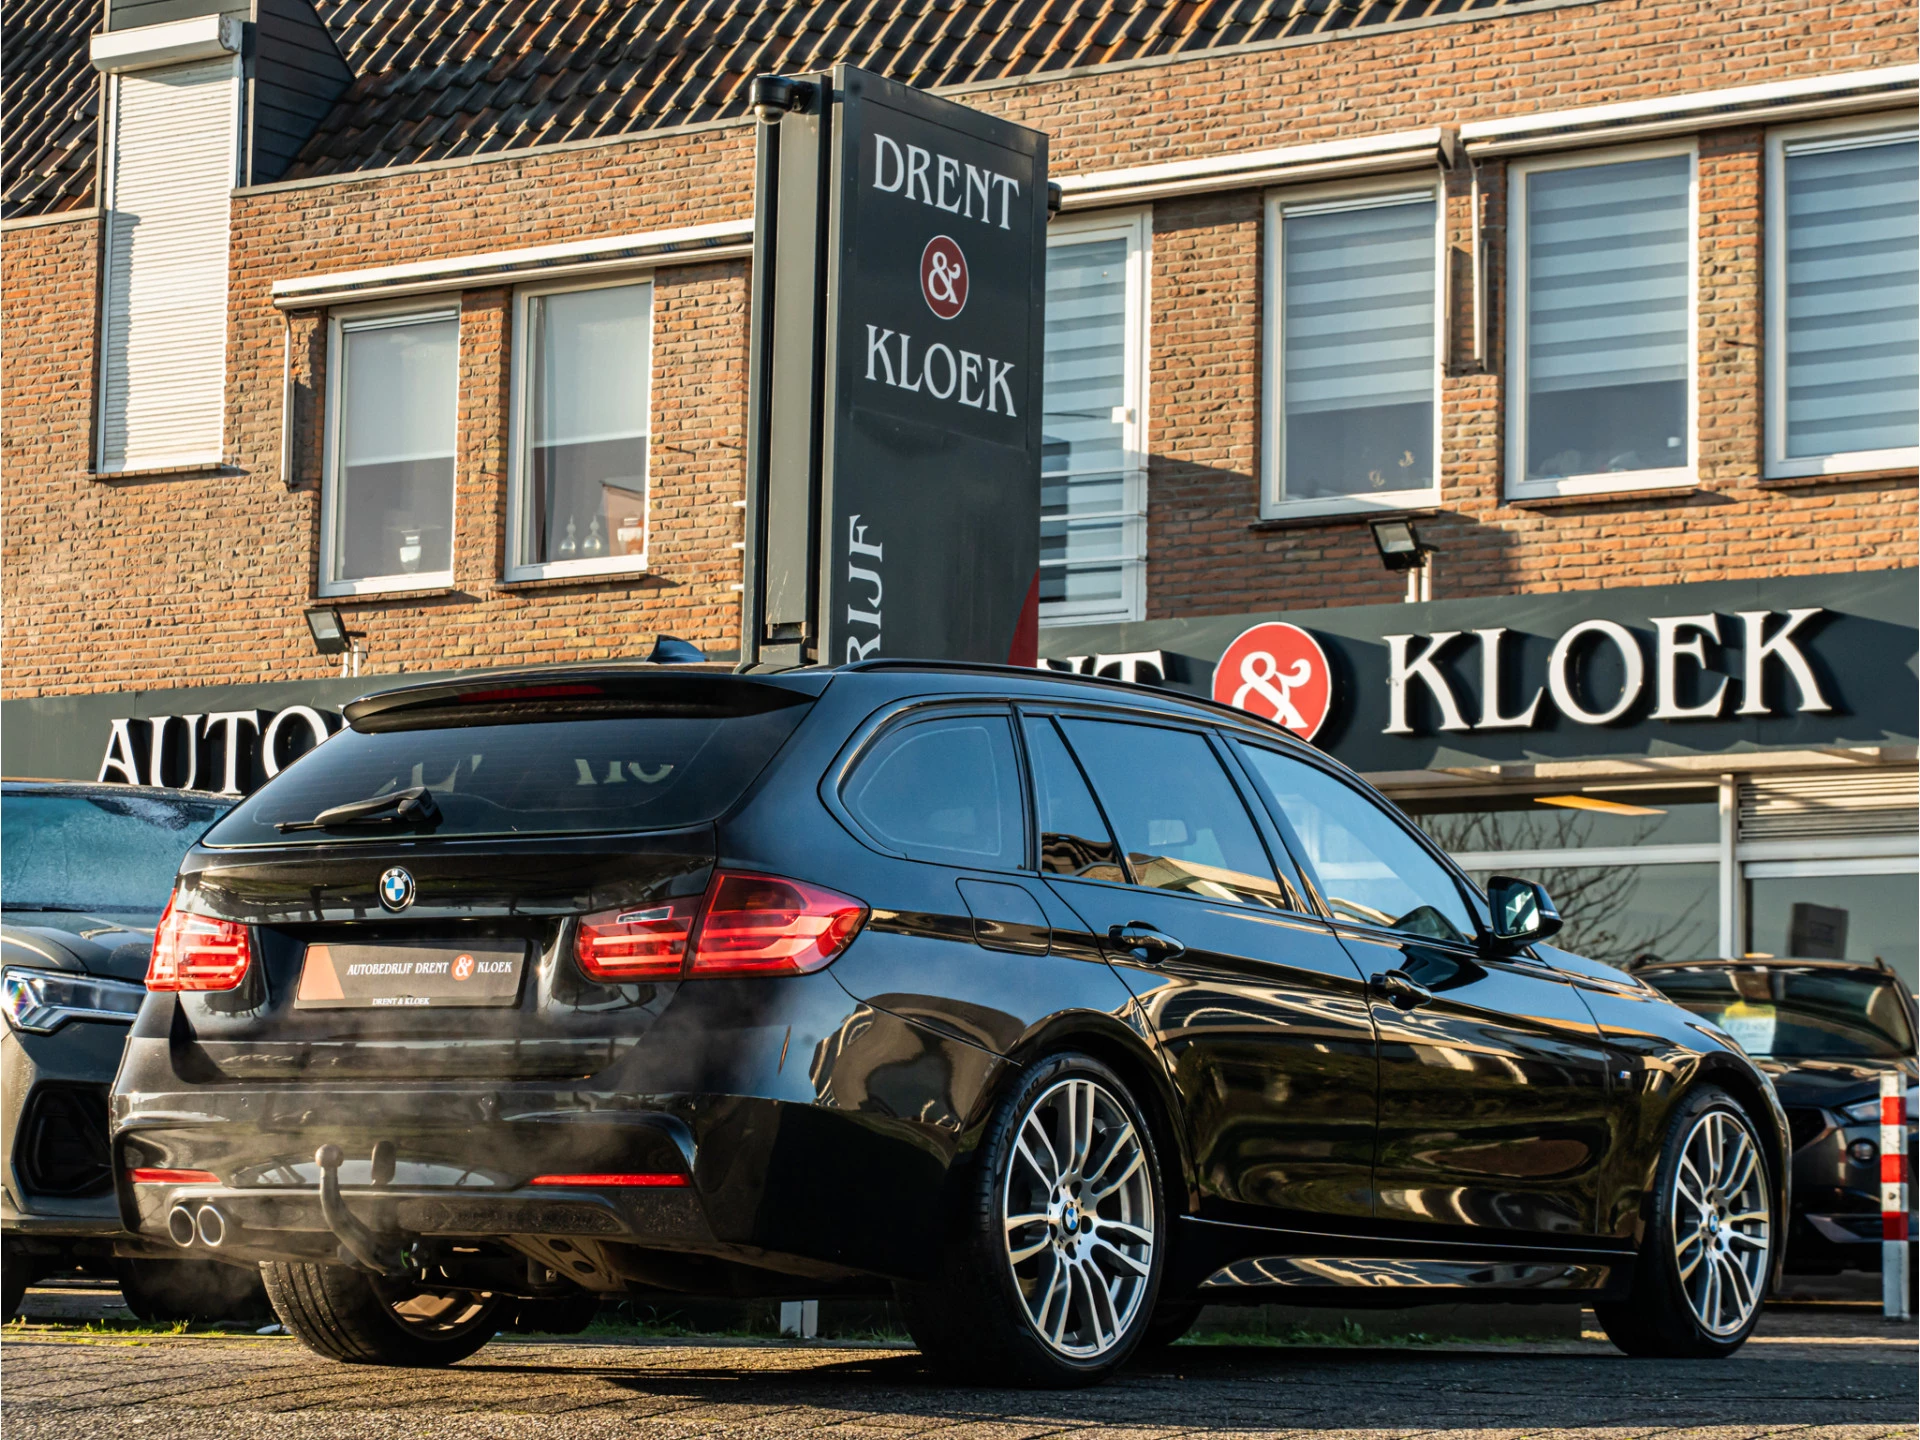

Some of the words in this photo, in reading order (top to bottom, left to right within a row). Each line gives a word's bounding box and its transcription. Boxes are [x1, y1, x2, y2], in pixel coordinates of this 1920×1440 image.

[873, 133, 1019, 230] DRENT
[928, 251, 961, 304] &
[866, 324, 1017, 417] KLOEK
[1232, 651, 1311, 729] &
[1382, 607, 1832, 734] KLOEK
[97, 704, 350, 794] AUTO
[347, 963, 413, 975] AUTOBEDRIJF
[415, 962, 449, 974] DRENT
[455, 957, 472, 976] &
[477, 961, 512, 973] KLOEK
